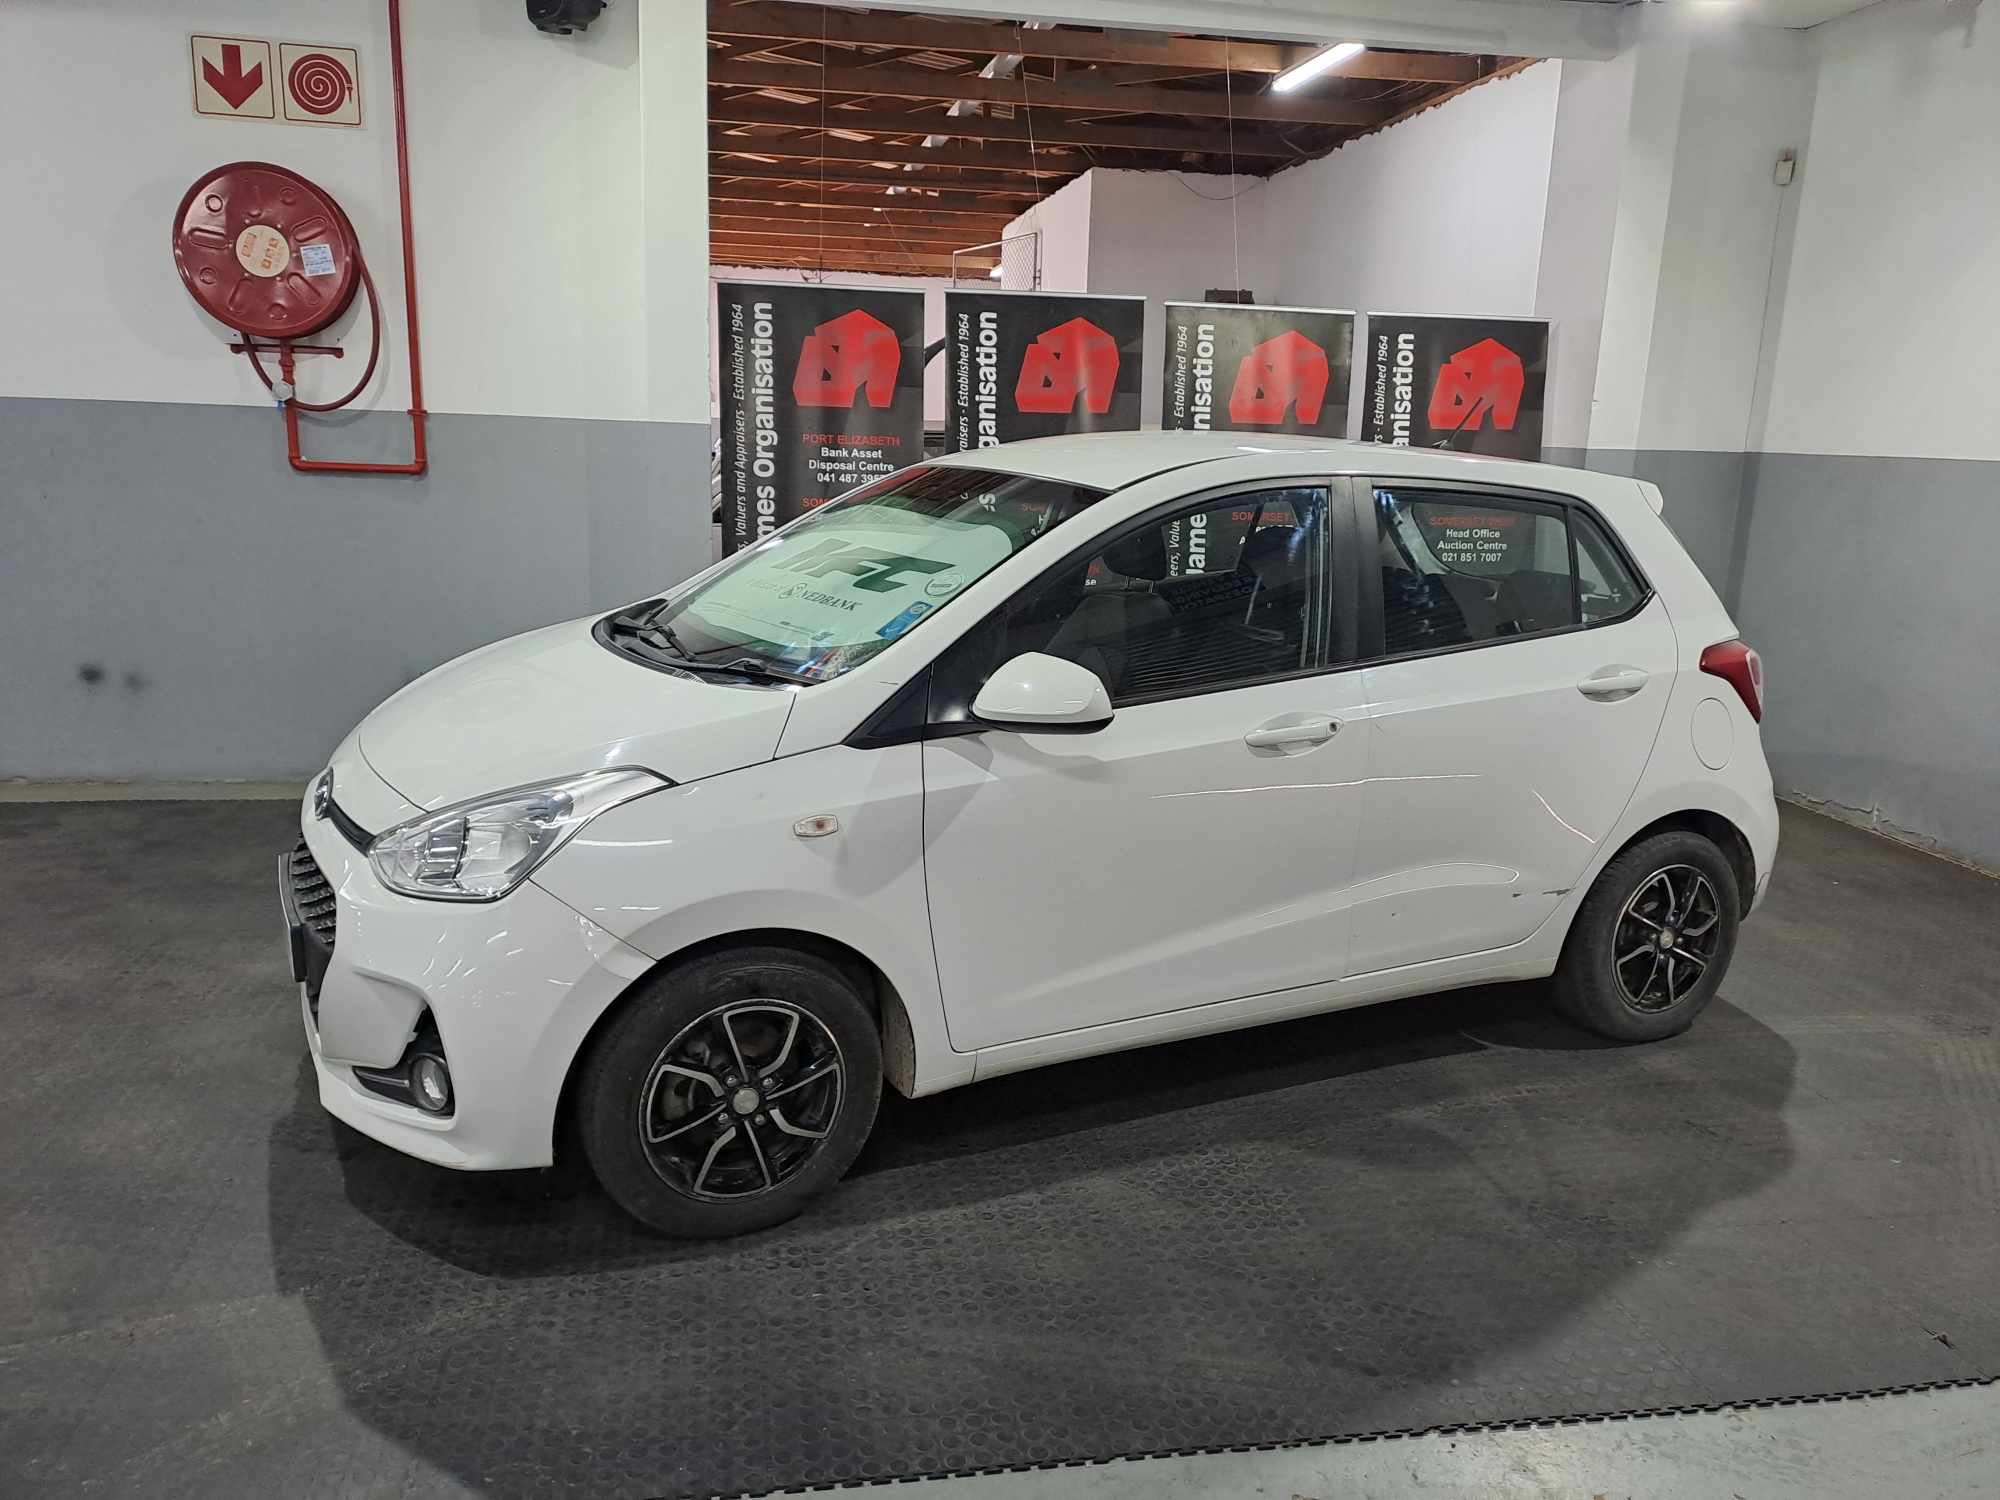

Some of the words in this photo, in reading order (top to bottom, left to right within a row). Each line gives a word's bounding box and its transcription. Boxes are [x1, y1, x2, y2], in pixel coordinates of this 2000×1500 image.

[731, 303, 744, 332] 1964
[958, 313, 969, 341] 1964
[1176, 325, 1188, 352] 1964
[1377, 335, 1389, 362] 1964
[731, 335, 745, 400] Established
[957, 341, 969, 407] Established
[750, 302, 779, 478] Organisation
[1173, 356, 1187, 418] Established
[1373, 364, 1386, 425] Established
[733, 410, 748, 469] Appraisers
[821, 447, 849, 458] Bank
[851, 448, 882, 459] Asset
[808, 459, 856, 471] Disposal
[858, 461, 894, 472] Centre
[817, 472, 835, 482] 041
[838, 473, 858, 483] 487
[734, 470, 746, 493] and
[735, 495, 746, 536] Valuers
[1437, 540, 1474, 550] Auction
[1476, 541, 1508, 551] Centre
[1446, 528, 1470, 538] Head
[1472, 529, 1501, 538] Office
[1441, 552, 1458, 562] 021
[1460, 552, 1477, 562] 851
[1480, 552, 1502, 562] 7007
[799, 589, 863, 611] NEDBANK
